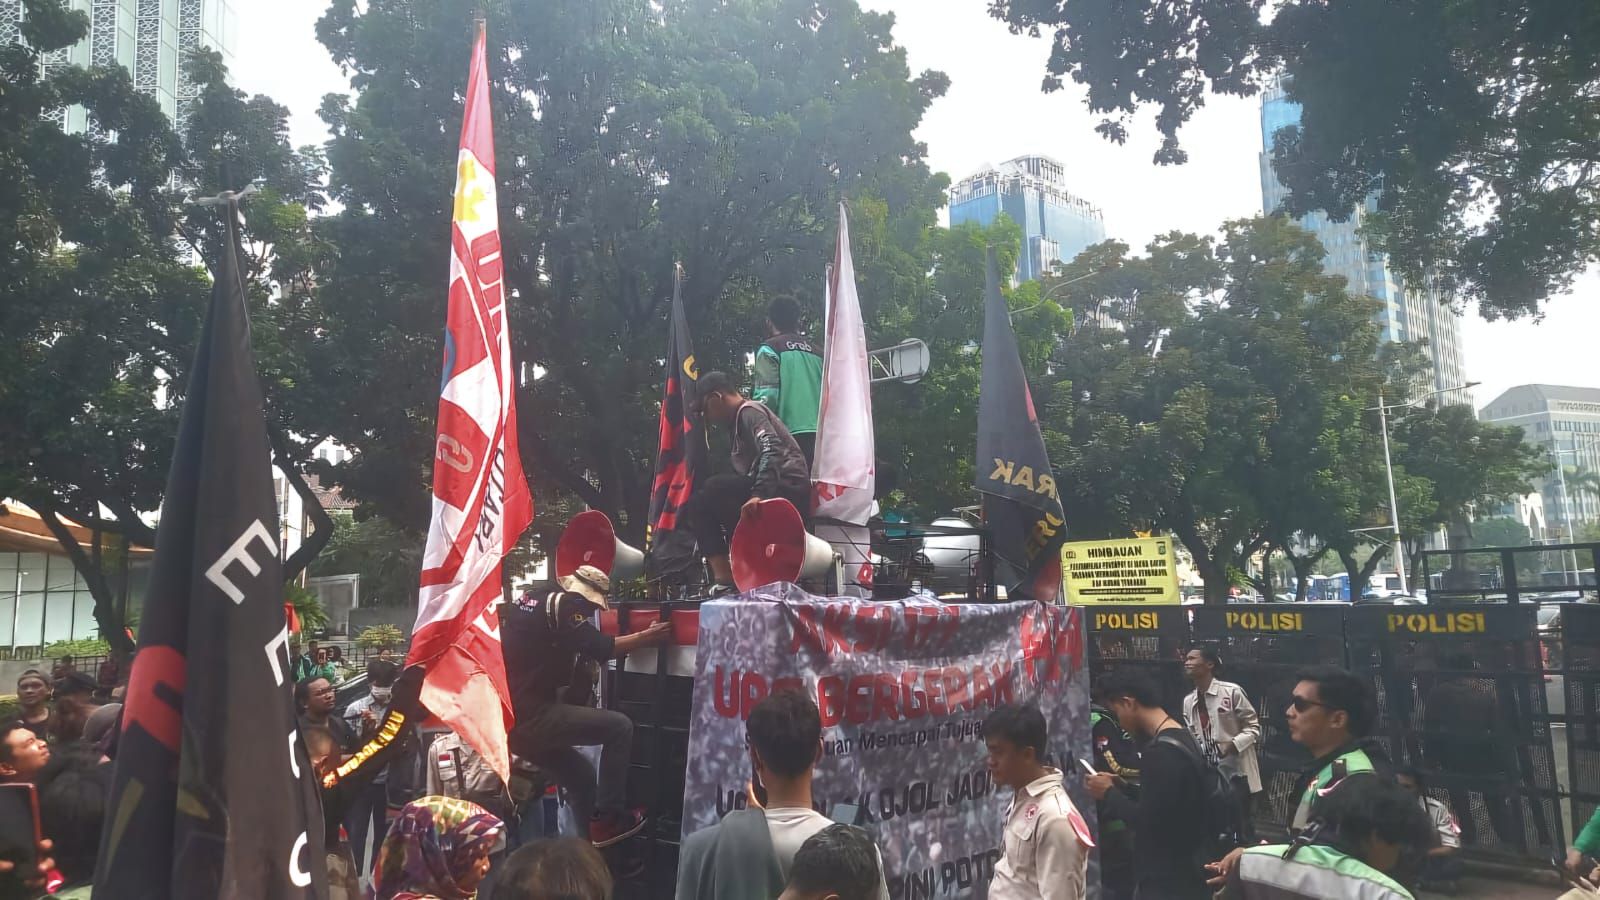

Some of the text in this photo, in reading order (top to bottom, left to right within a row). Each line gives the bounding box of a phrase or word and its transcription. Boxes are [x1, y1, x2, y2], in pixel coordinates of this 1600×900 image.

[786, 341, 812, 352] Grab
[1087, 546, 1143, 559] HIMBAUAN
[1095, 612, 1158, 629] POLISI
[1226, 612, 1303, 631] POLISI
[1387, 612, 1486, 633] POLISI
[817, 660, 1014, 728] BERGERAK
[858, 725, 942, 751] Mencapai
[879, 781, 941, 821] OJOL
